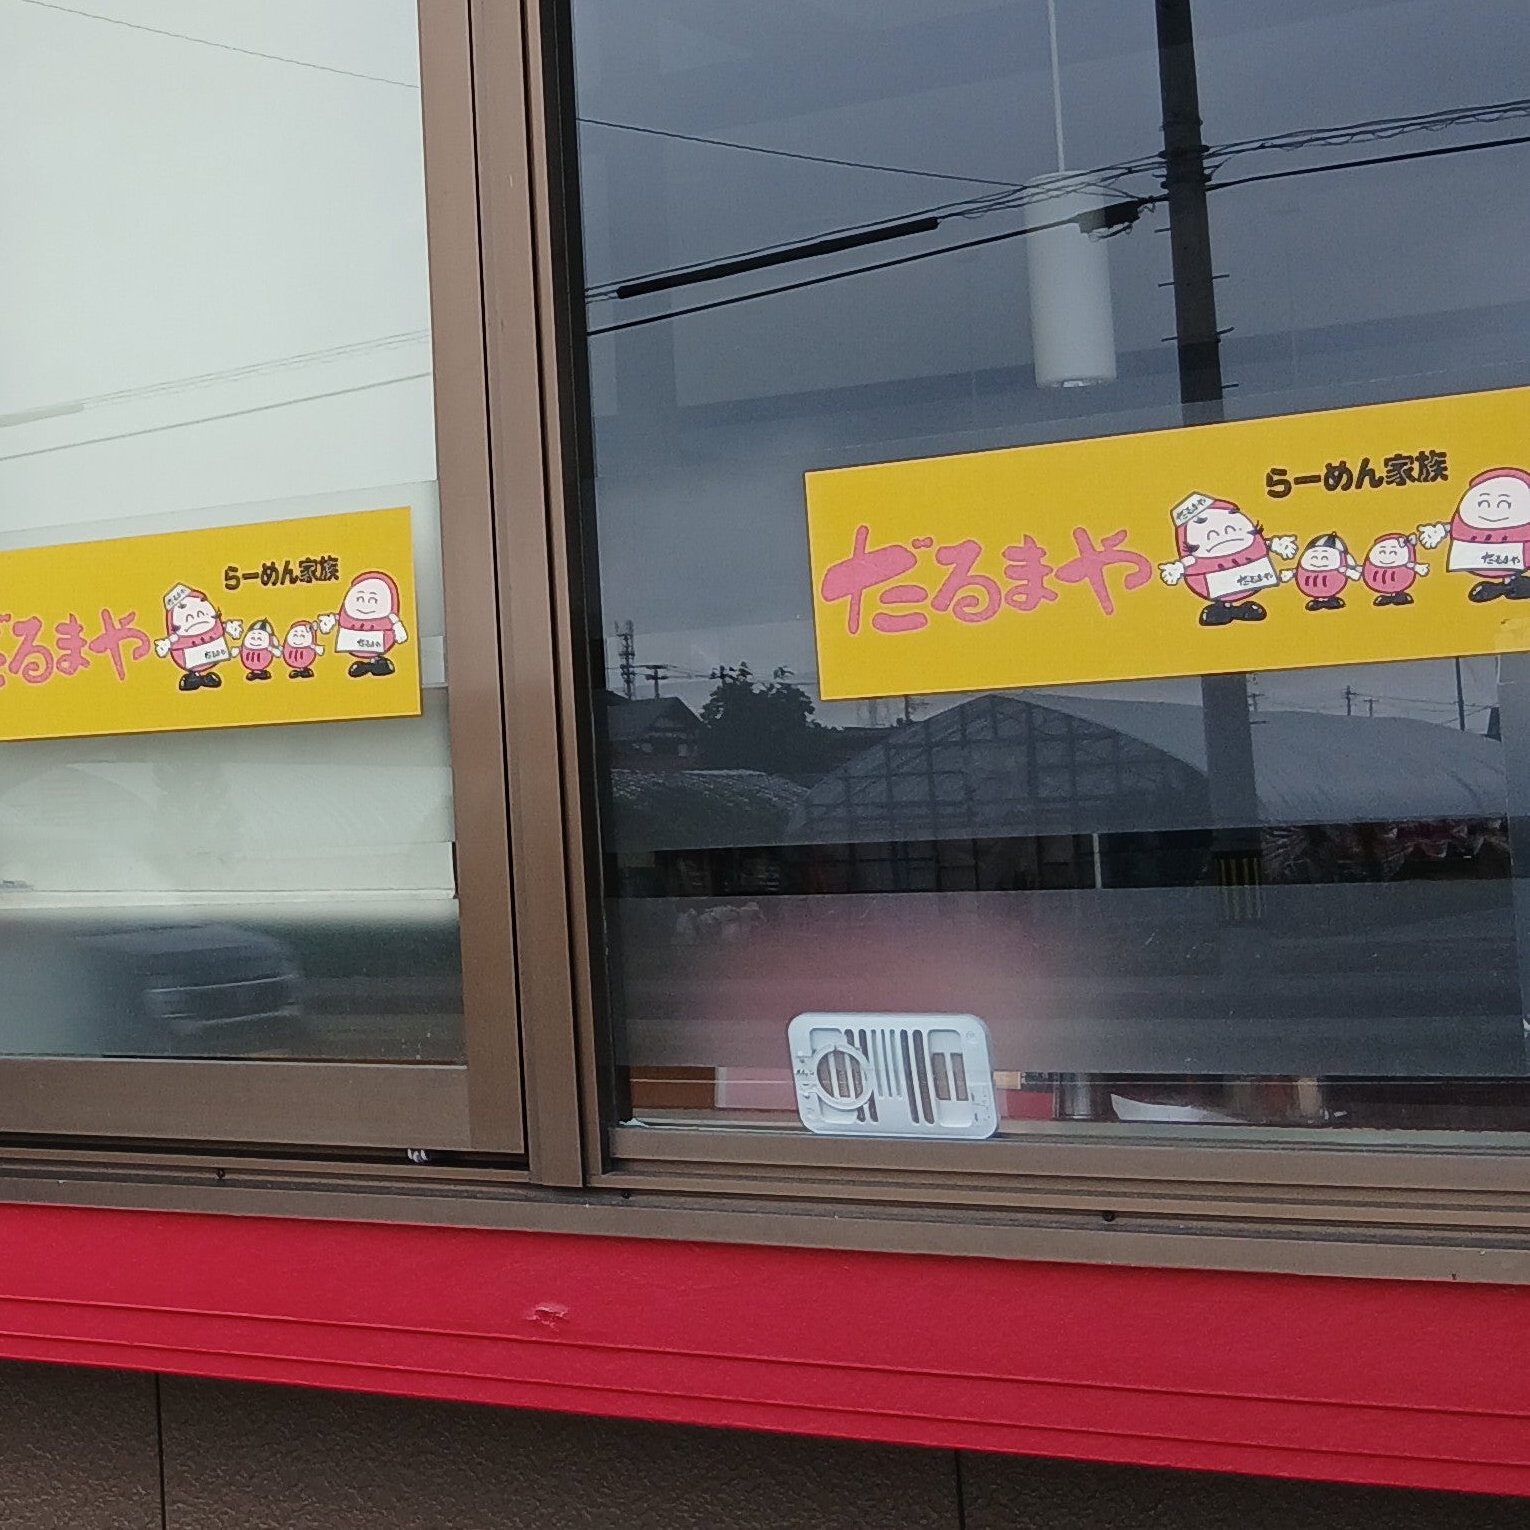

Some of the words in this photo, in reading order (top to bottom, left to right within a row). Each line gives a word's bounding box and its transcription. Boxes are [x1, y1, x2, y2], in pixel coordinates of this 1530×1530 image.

[1264, 449, 1450, 500] らーめん家族
[224, 554, 339, 591] らーめん家族
[822, 524, 1153, 636] だるまや
